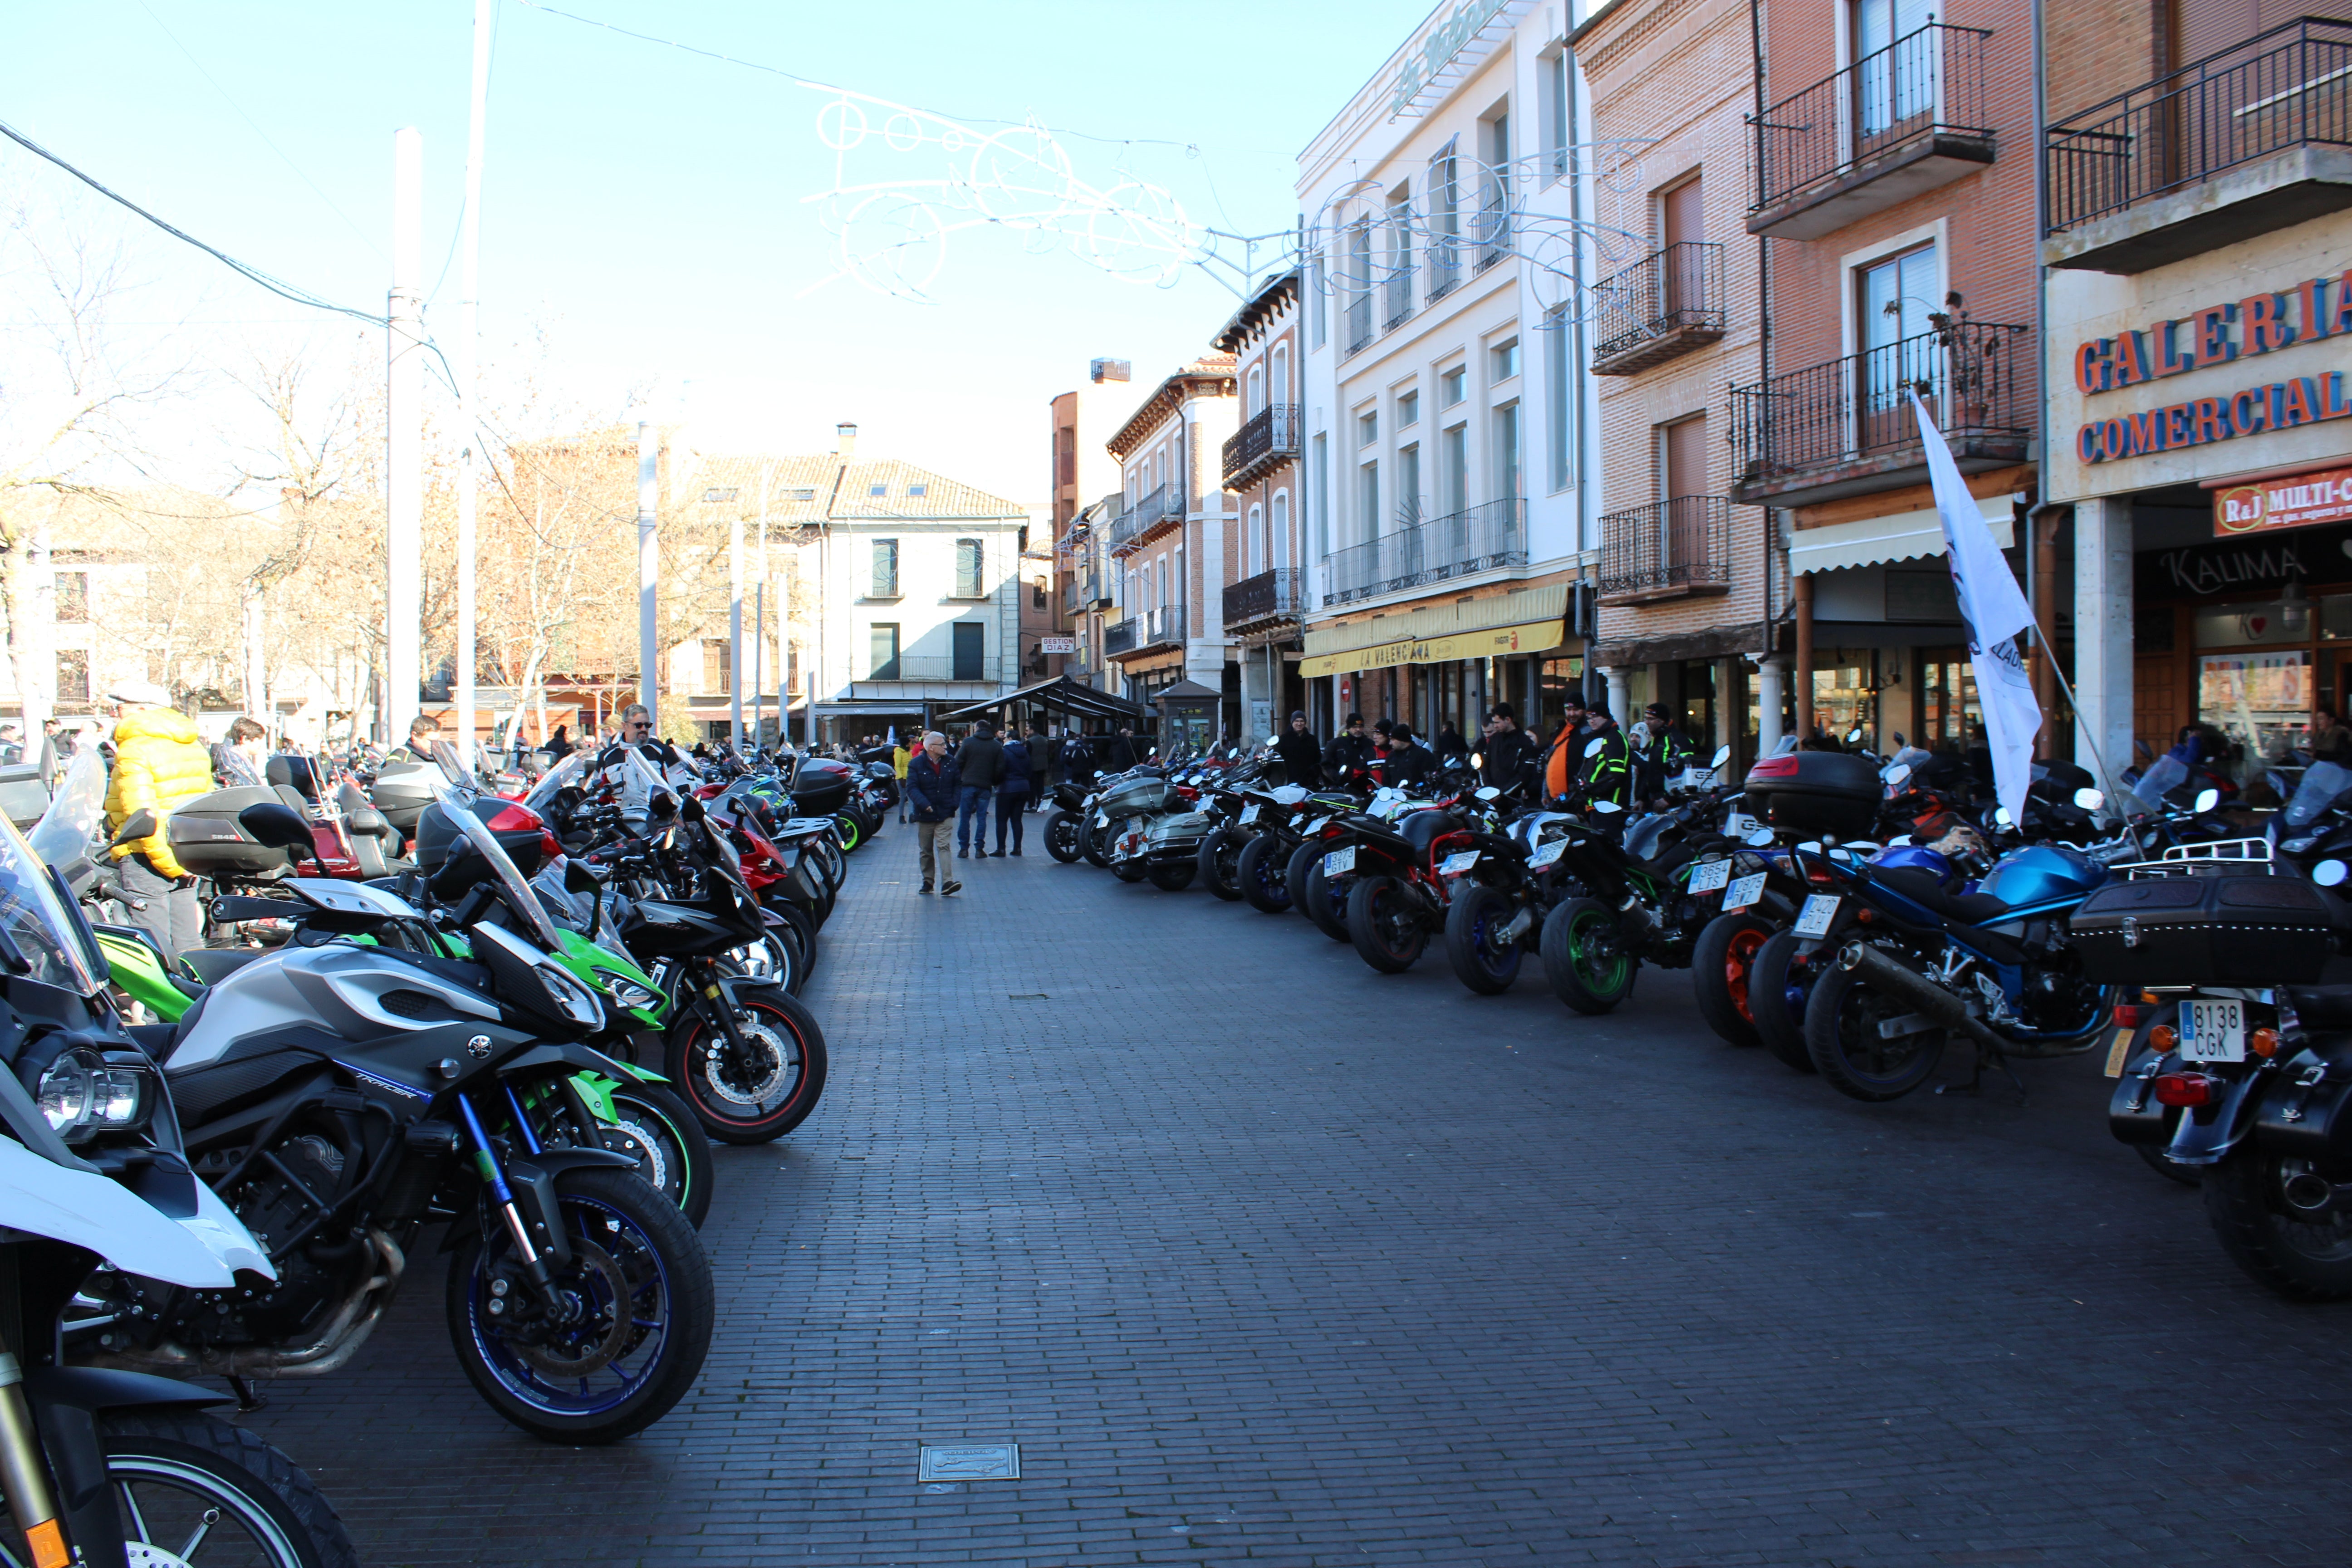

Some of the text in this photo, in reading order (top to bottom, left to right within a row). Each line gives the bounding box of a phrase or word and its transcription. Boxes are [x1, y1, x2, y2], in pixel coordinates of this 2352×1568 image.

[2077, 370, 2352, 465] COMERCIAL
[2225, 495, 2262, 523] R&J
[2160, 547, 2308, 594] KALIMA
[1331, 848, 1353, 862] 3273
[1331, 859, 1348, 873] GTV
[1700, 862, 1727, 878] 3654
[1698, 875, 1720, 890] LTS
[1735, 876, 1764, 893] 2875
[1730, 891, 1754, 906] DWZ
[1809, 898, 1838, 914] 2420
[2194, 1005, 2238, 1029] 8138
[2195, 1032, 2228, 1056] CGK
[356, 1072, 417, 1099] TRACER
